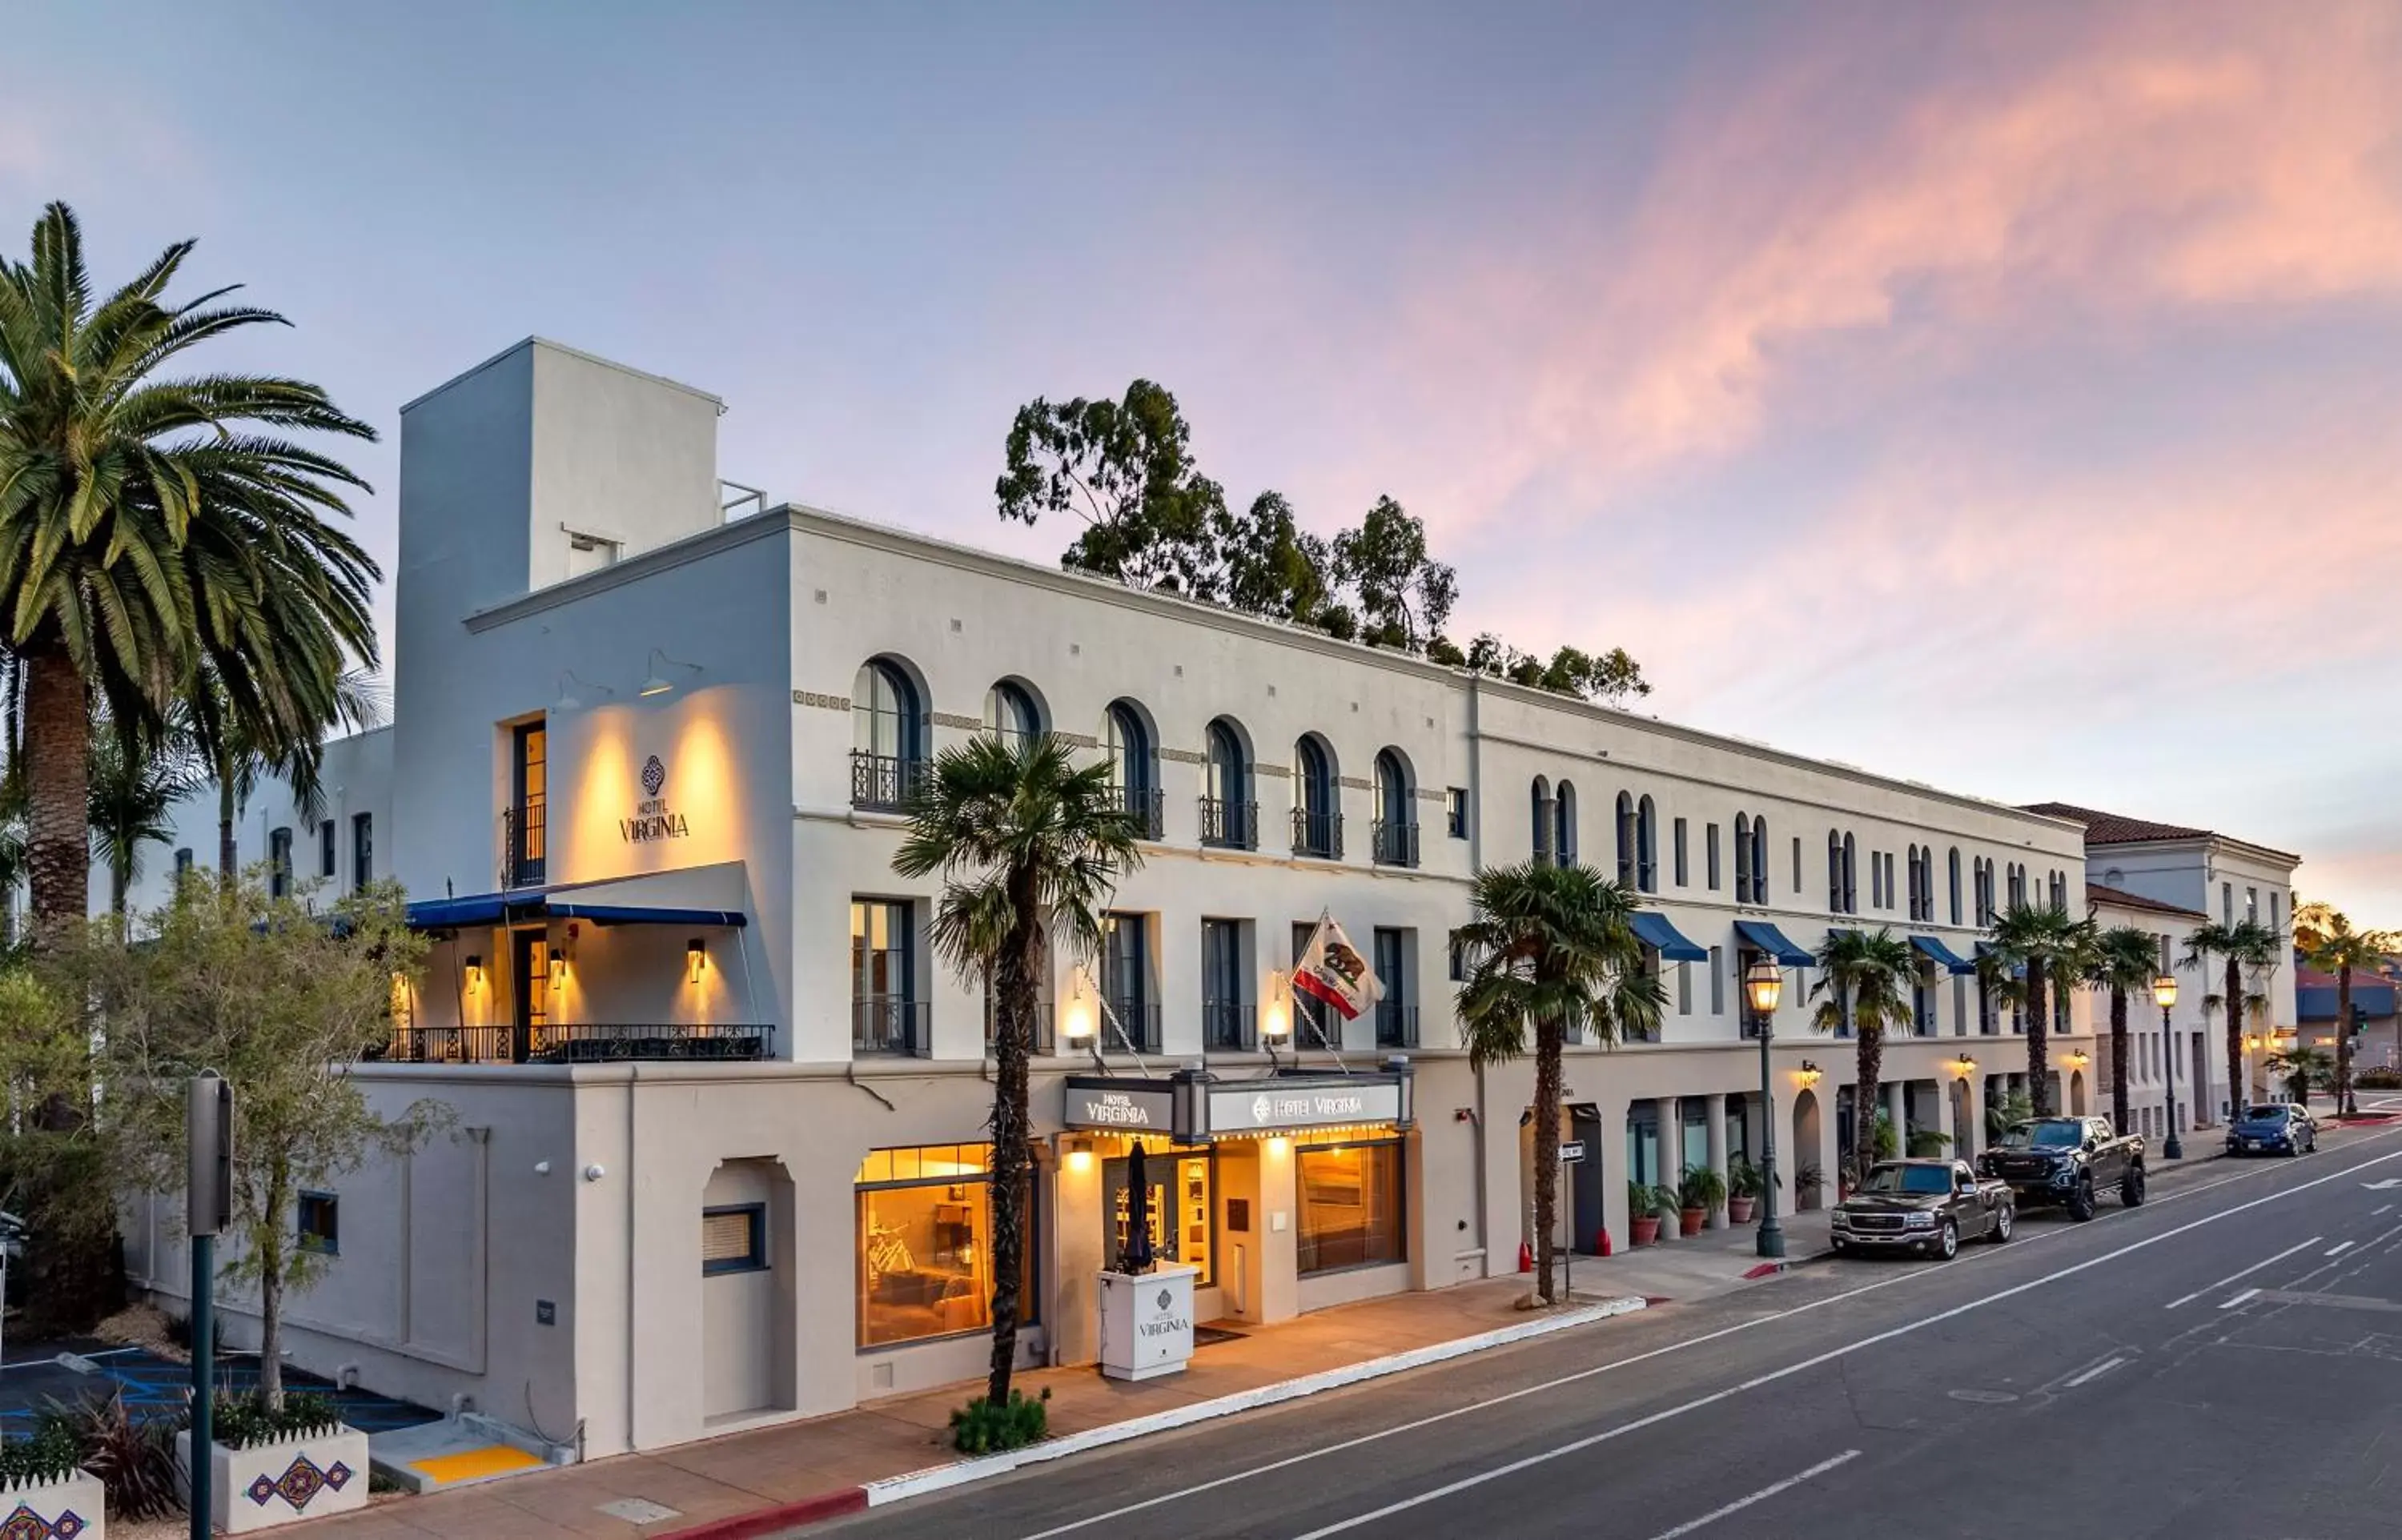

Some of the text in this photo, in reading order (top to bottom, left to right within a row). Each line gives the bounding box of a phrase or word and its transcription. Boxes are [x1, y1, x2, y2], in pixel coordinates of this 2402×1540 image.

[620, 813, 689, 844] VIRGINIA
[1087, 1102, 1148, 1124] VIRGINIA
[1275, 1097, 1362, 1117] HOTEL VIRGINIA
[1139, 1318, 1189, 1337] VIRGINIA
